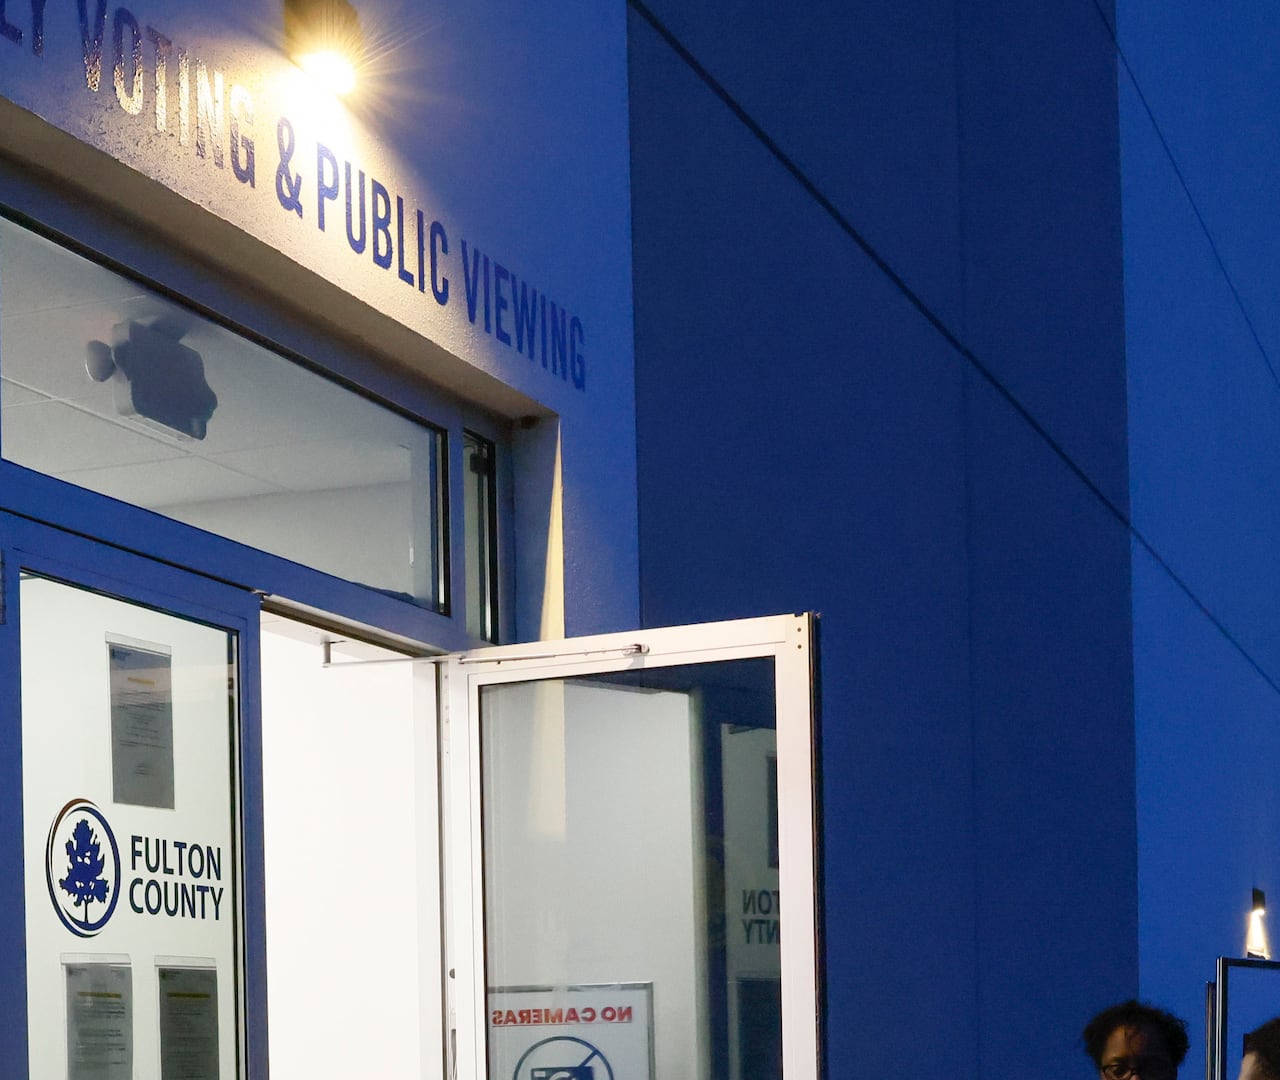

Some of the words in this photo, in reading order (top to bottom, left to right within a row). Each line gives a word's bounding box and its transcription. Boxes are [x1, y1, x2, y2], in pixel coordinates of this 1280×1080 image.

[78, 0, 256, 189] VOTING
[275, 116, 304, 218] &
[317, 141, 450, 306] PUBLIC
[460, 238, 586, 393] VIEWING
[130, 834, 221, 881] FULTON
[128, 878, 224, 921] COUNTY
